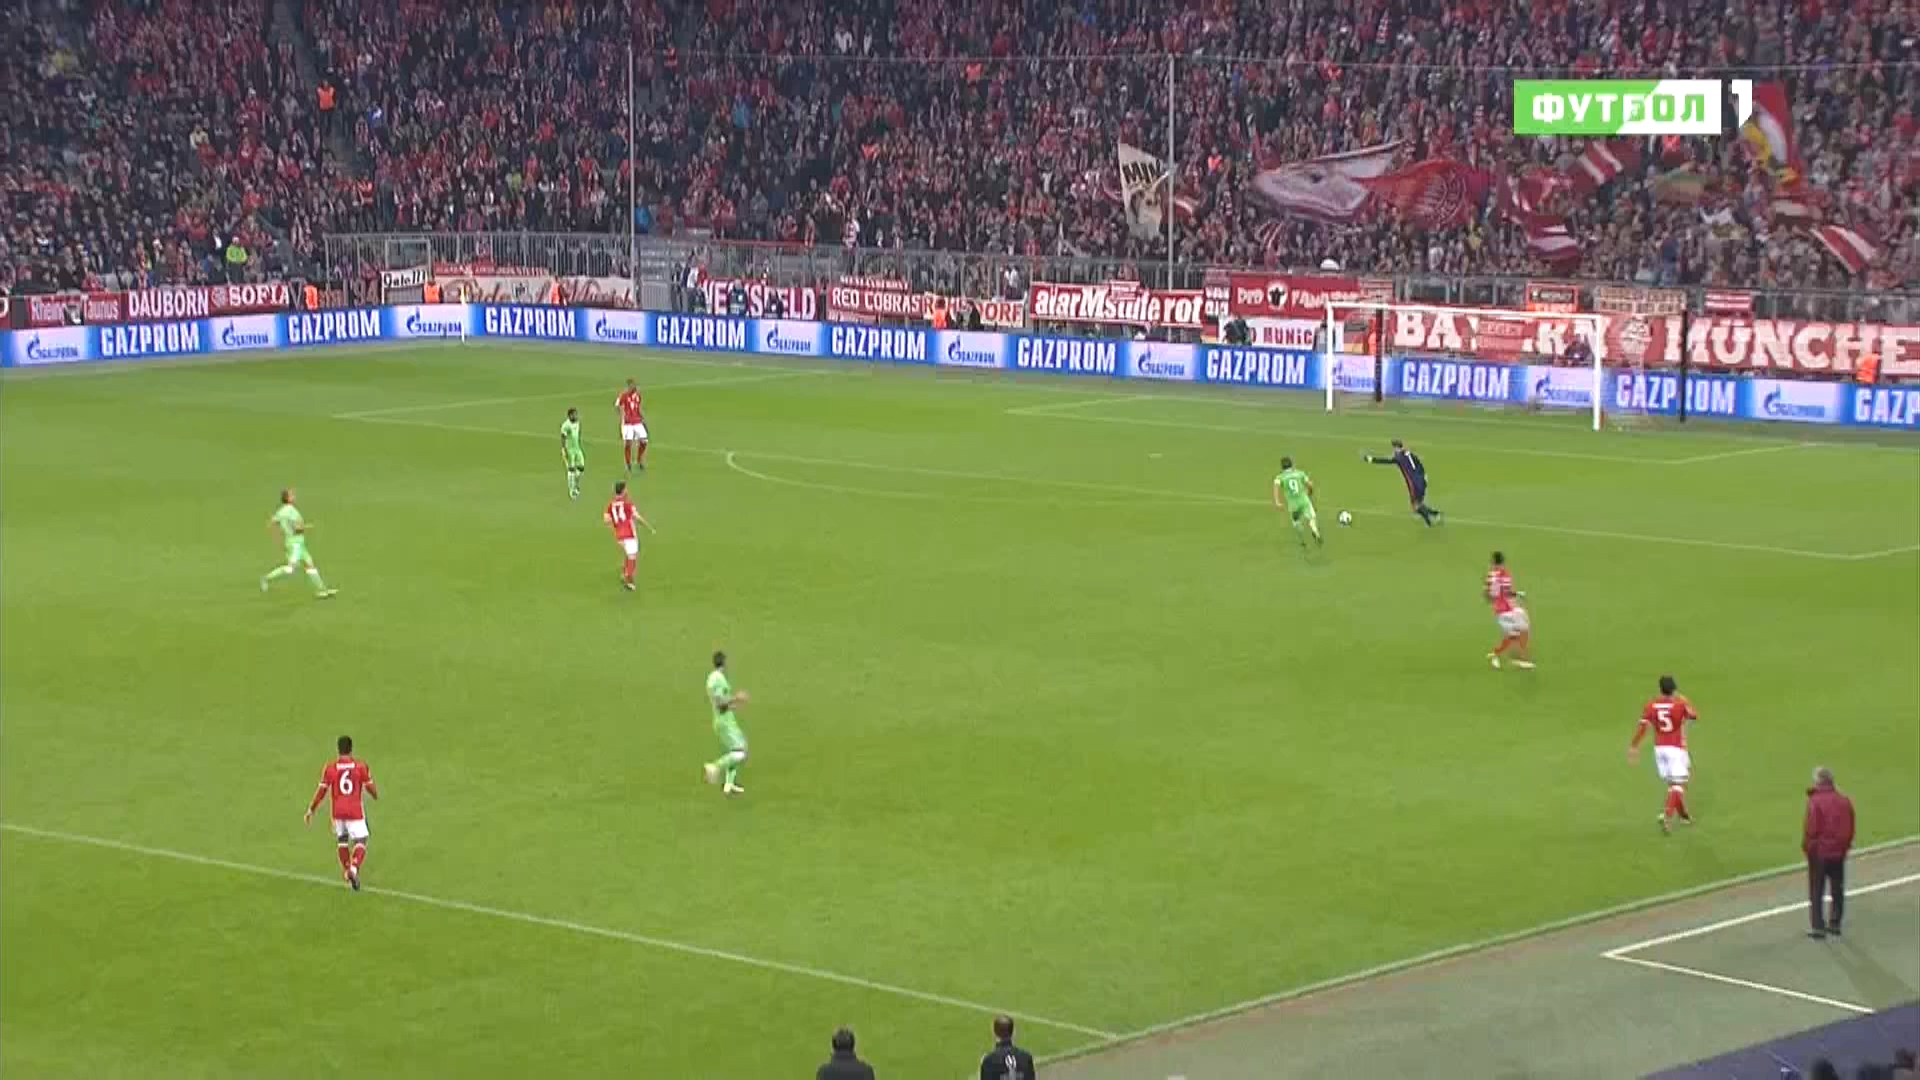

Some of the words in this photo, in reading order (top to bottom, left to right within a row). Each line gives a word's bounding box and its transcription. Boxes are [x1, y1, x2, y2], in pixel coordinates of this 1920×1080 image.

[81, 294, 119, 320] Taunus
[128, 288, 209, 317] DAUBORN
[229, 284, 290, 307] SOFIA
[864, 290, 921, 314] COBRAS
[288, 309, 380, 344] GAZPROM
[485, 307, 575, 337] GAZPROM
[657, 315, 745, 348] GAZPROM
[1263, 326, 1313, 345] MUNIC
[1395, 309, 1611, 358] BARN
[101, 321, 199, 356] GAZPROM
[832, 326, 926, 360] GAZPROM
[1017, 337, 1116, 373] GAZPROM
[1206, 349, 1305, 385] GAZPROM
[1403, 361, 1511, 400] GAZPROM
[1288, 478, 1299, 495] 9
[1657, 709, 1675, 733] 5
[339, 770, 353, 795] 6
